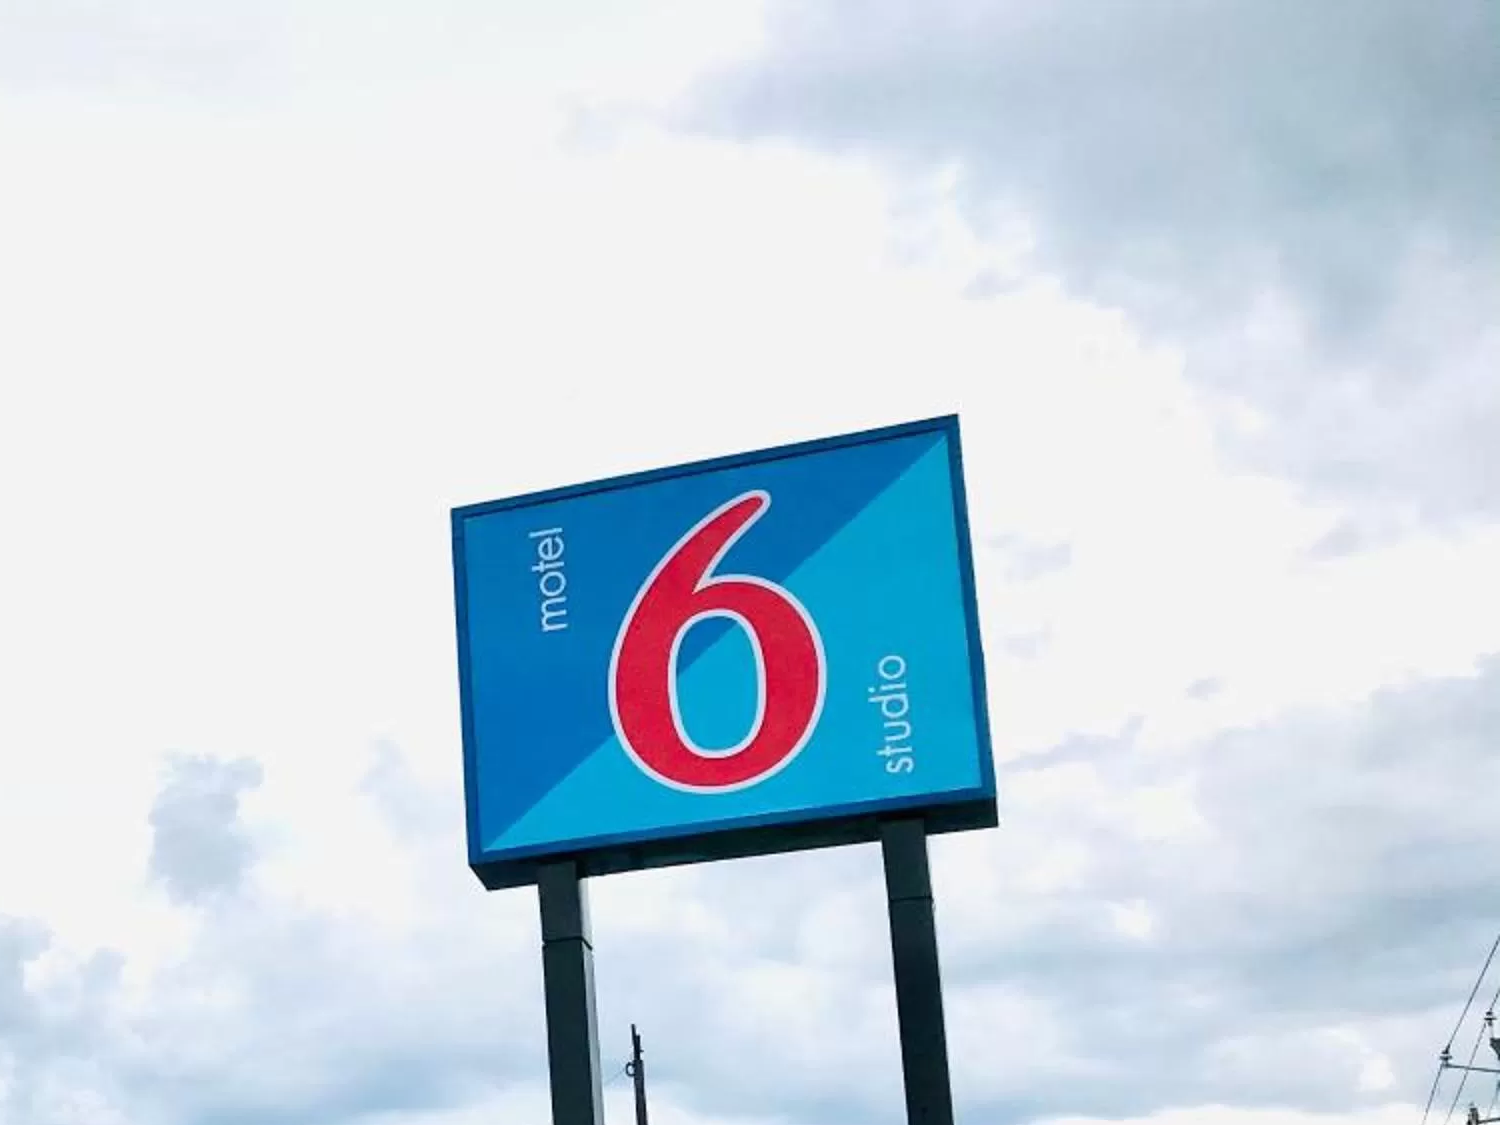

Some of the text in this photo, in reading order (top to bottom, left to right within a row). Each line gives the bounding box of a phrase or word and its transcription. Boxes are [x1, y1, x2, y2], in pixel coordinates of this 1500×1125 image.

[529, 527, 568, 632] motel
[608, 490, 826, 794] 6
[868, 655, 914, 775] studio
